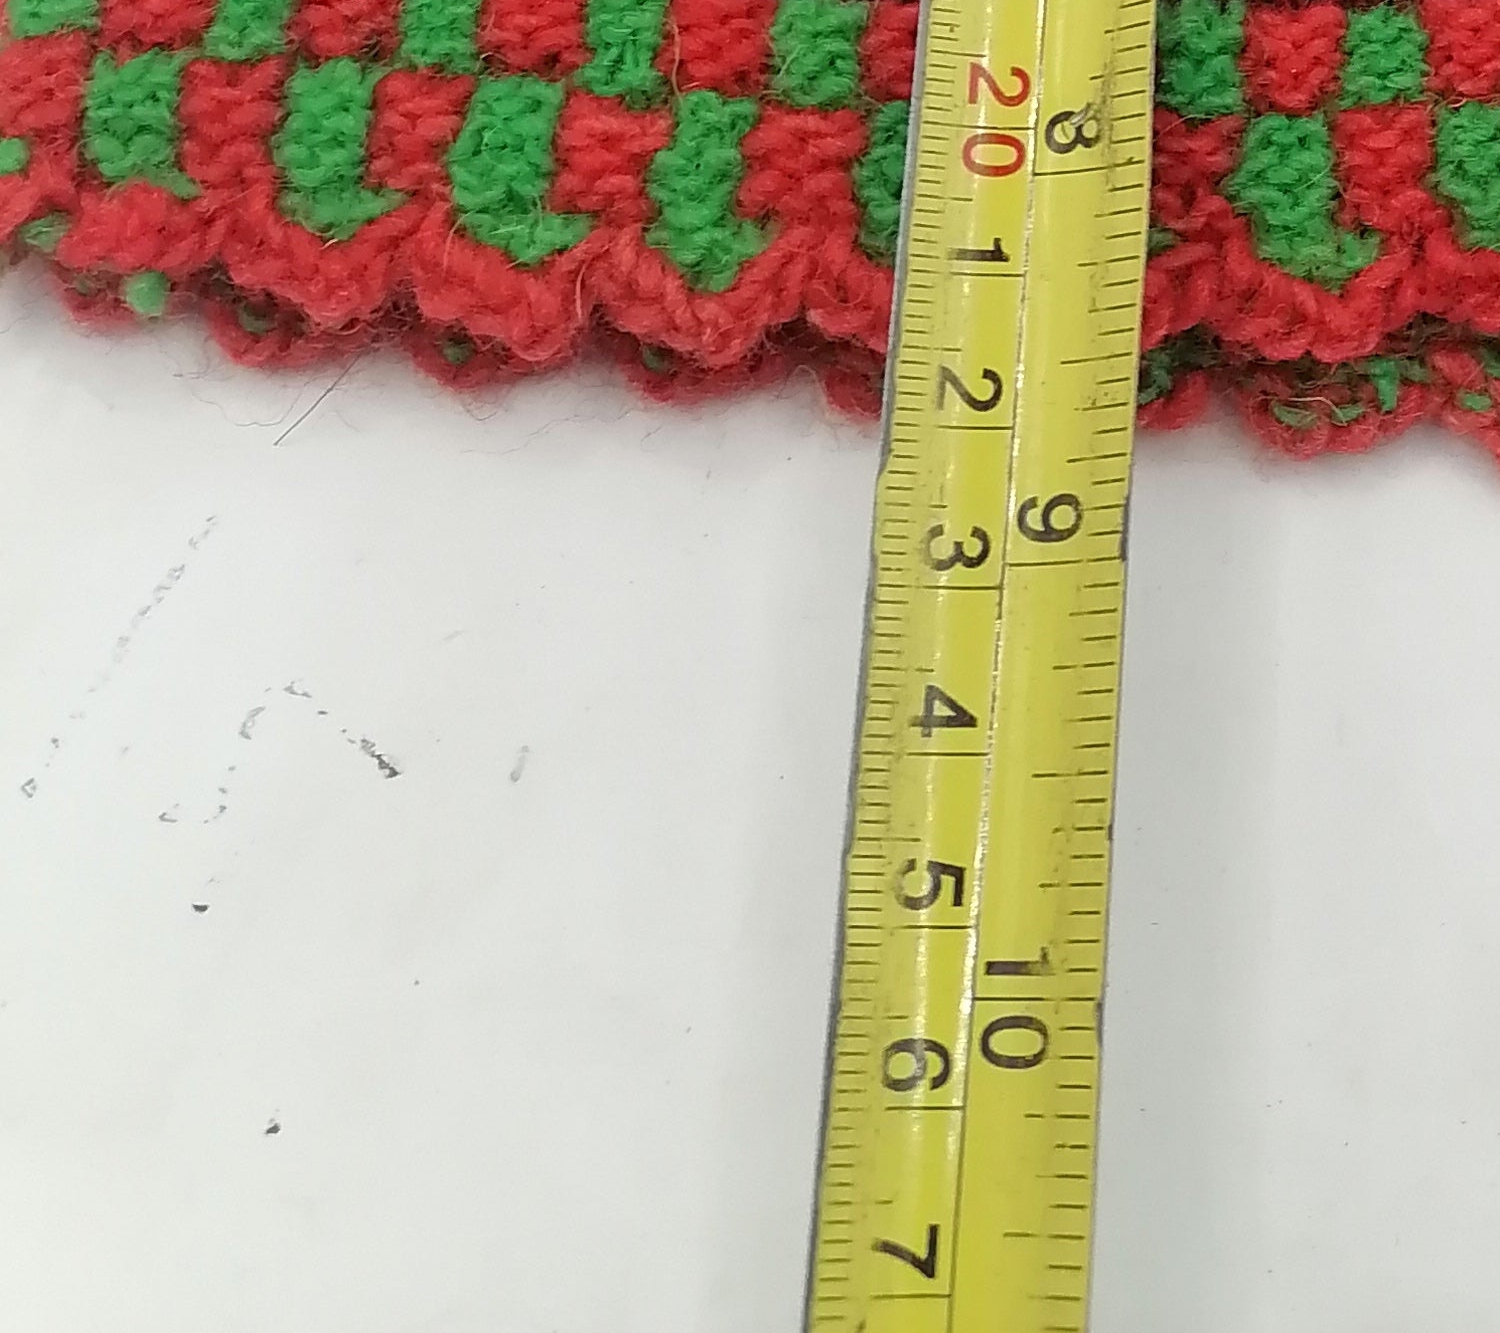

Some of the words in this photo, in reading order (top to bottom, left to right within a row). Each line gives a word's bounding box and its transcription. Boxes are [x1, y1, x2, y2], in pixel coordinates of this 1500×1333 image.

[1045, 103, 1102, 154] 8
[947, 237, 1010, 263] 1
[934, 365, 1003, 412] 2
[1018, 492, 1083, 543] 9
[924, 523, 991, 571] 3
[908, 684, 977, 738] 4
[895, 858, 966, 911] 5
[882, 1037, 951, 1092] 6
[872, 1223, 939, 1279] 7
